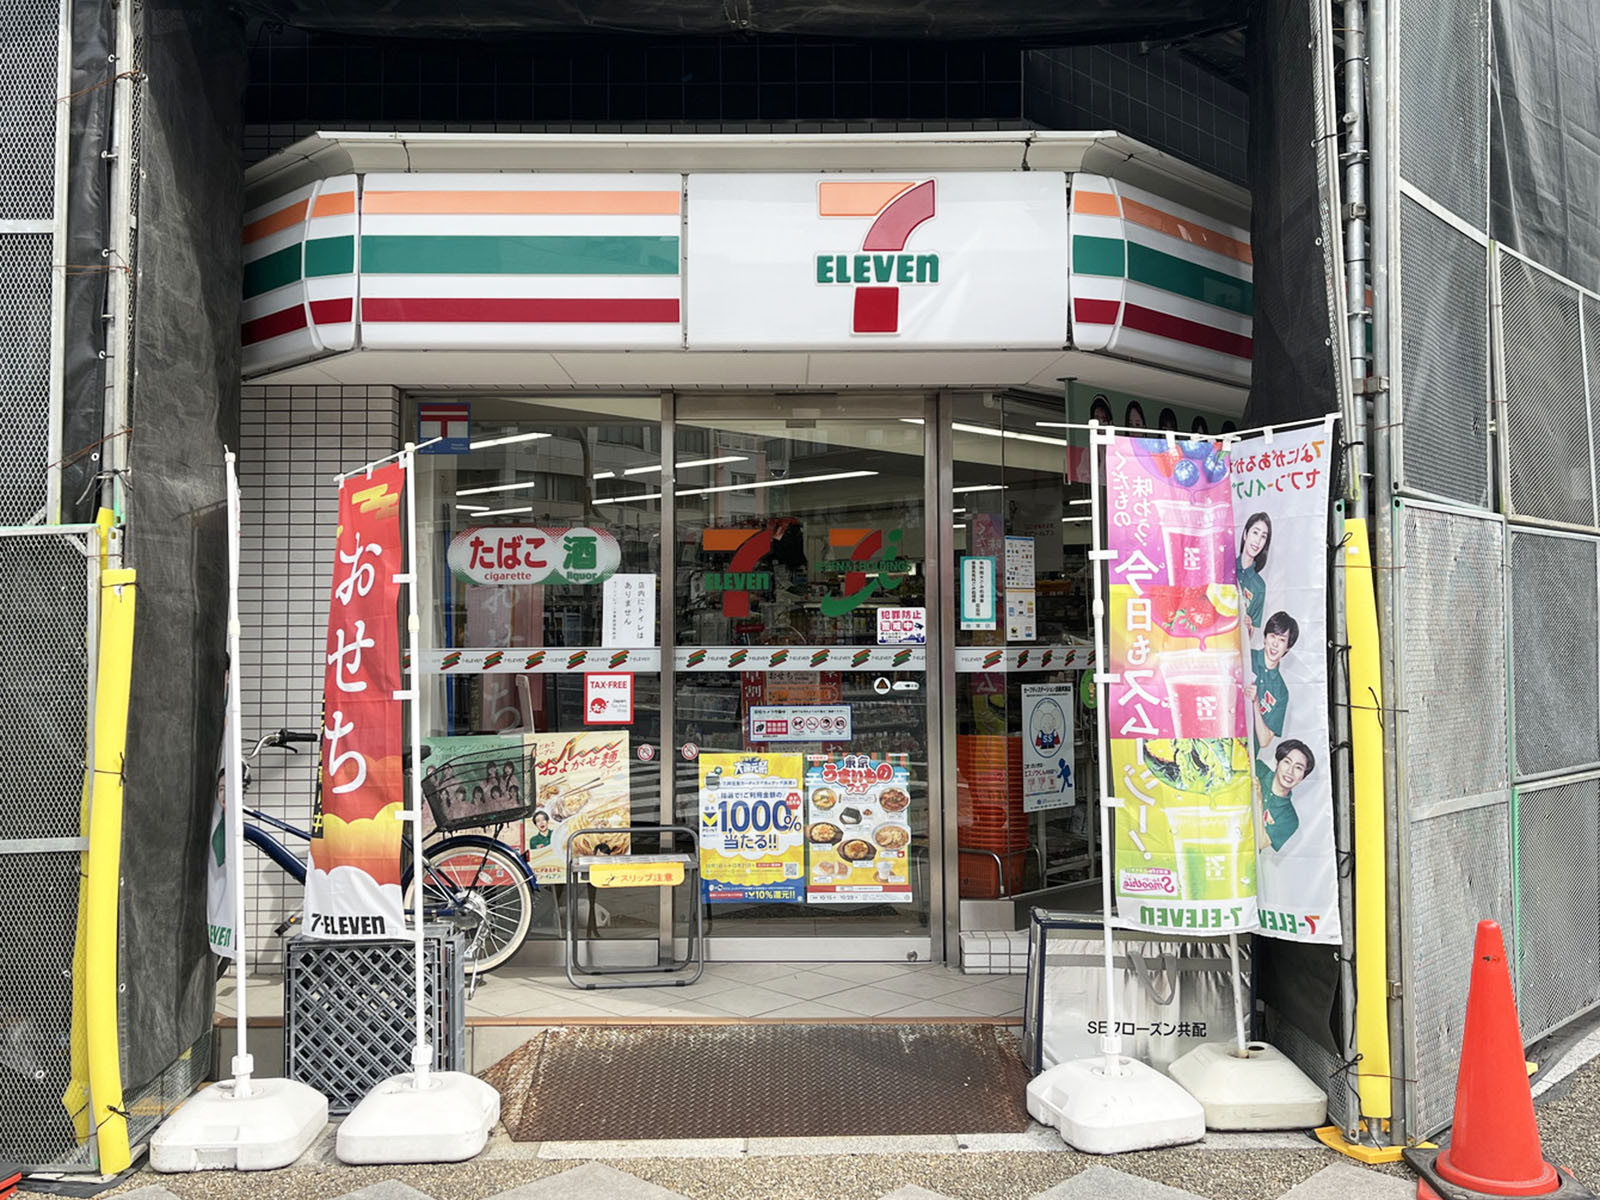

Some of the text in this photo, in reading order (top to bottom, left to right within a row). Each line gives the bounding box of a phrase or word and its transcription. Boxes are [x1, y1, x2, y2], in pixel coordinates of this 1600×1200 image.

[469, 535, 547, 569] たばこ
[563, 536, 597, 570] 酒
[484, 572, 532, 582] cigarette
[566, 572, 598, 582] liquor
[624, 582, 632, 625] ありません
[881, 610, 922, 620] 犯罪防止
[325, 531, 382, 794] おせち
[590, 680, 627, 688] TAX-FREE
[846, 756, 868, 768] 東京
[823, 764, 893, 784] うまいもの
[846, 784, 868, 792] フェア
[724, 834, 776, 849] 当たる!!
[620, 874, 674, 883] スリップ注意
